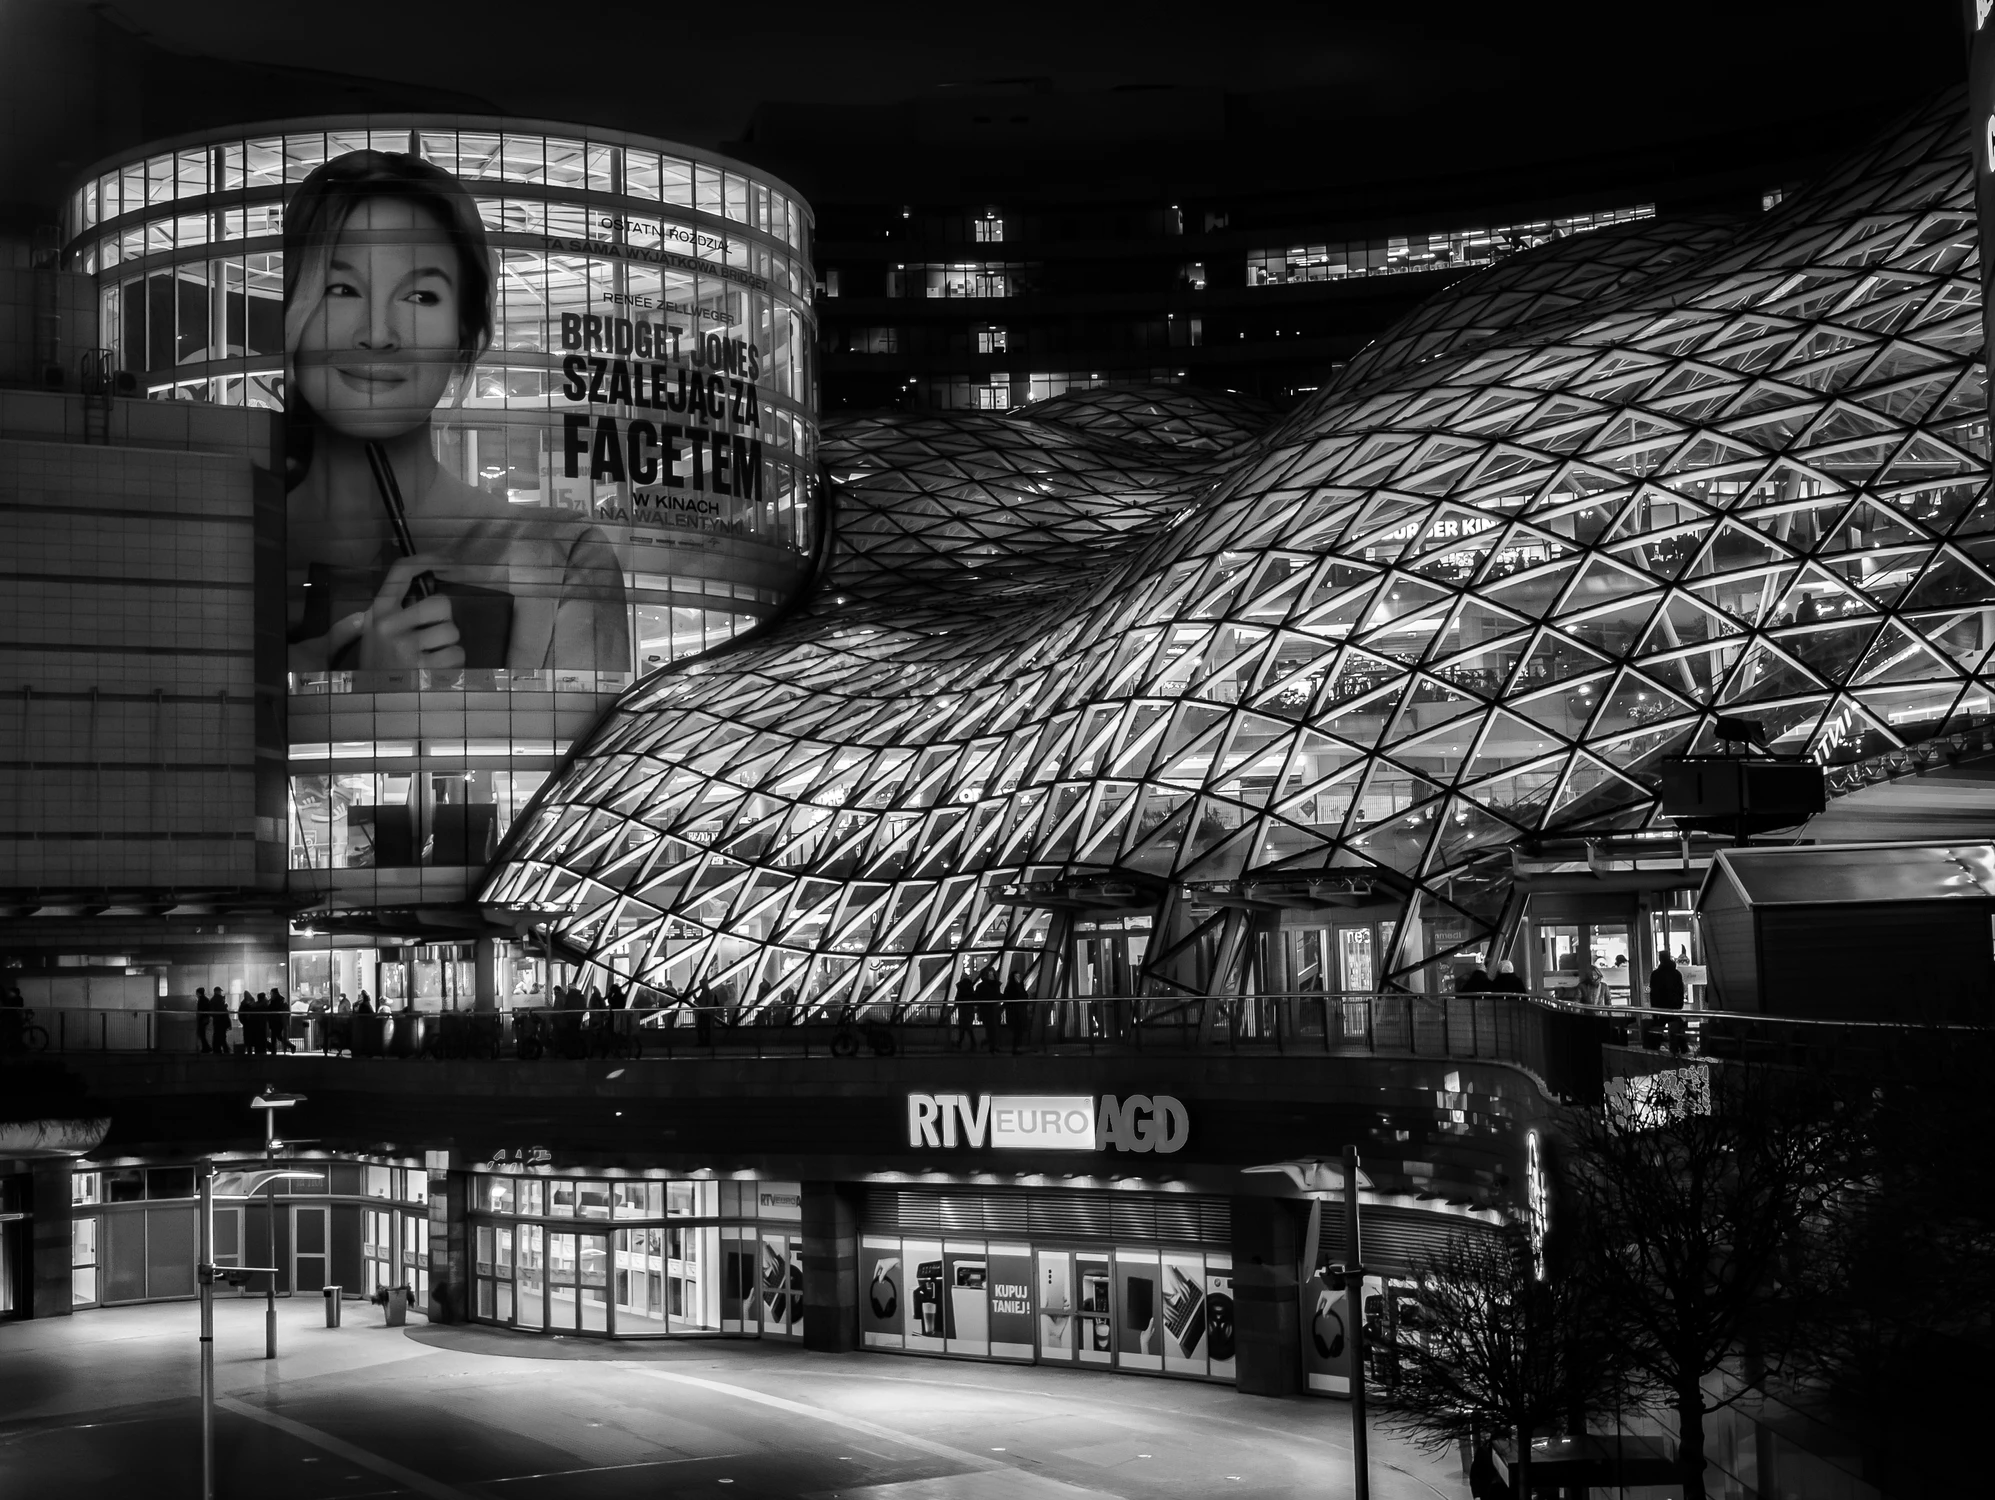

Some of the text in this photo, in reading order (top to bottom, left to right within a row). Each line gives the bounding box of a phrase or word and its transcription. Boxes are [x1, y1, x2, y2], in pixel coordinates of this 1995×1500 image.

[541, 238, 564, 250] TA
[569, 240, 621, 258] SAMA
[720, 267, 768, 291] BRIDGET
[602, 293, 735, 325] RENÉE ZELLWEGER
[561, 312, 760, 381] BRIDGET JONES
[563, 354, 760, 430] SZALEJĄC ZA
[563, 413, 763, 501] FACETEM
[632, 492, 719, 515] W KINACH
[600, 506, 743, 534] NA WALENTYNKI
[908, 1093, 1189, 1153] RTV EURO AGD
[760, 1193, 776, 1207] RTV
[775, 1196, 797, 1206] EURO
[992, 1299, 1030, 1315] TANIEJ!
[995, 1284, 1027, 1299] KUPUJ
